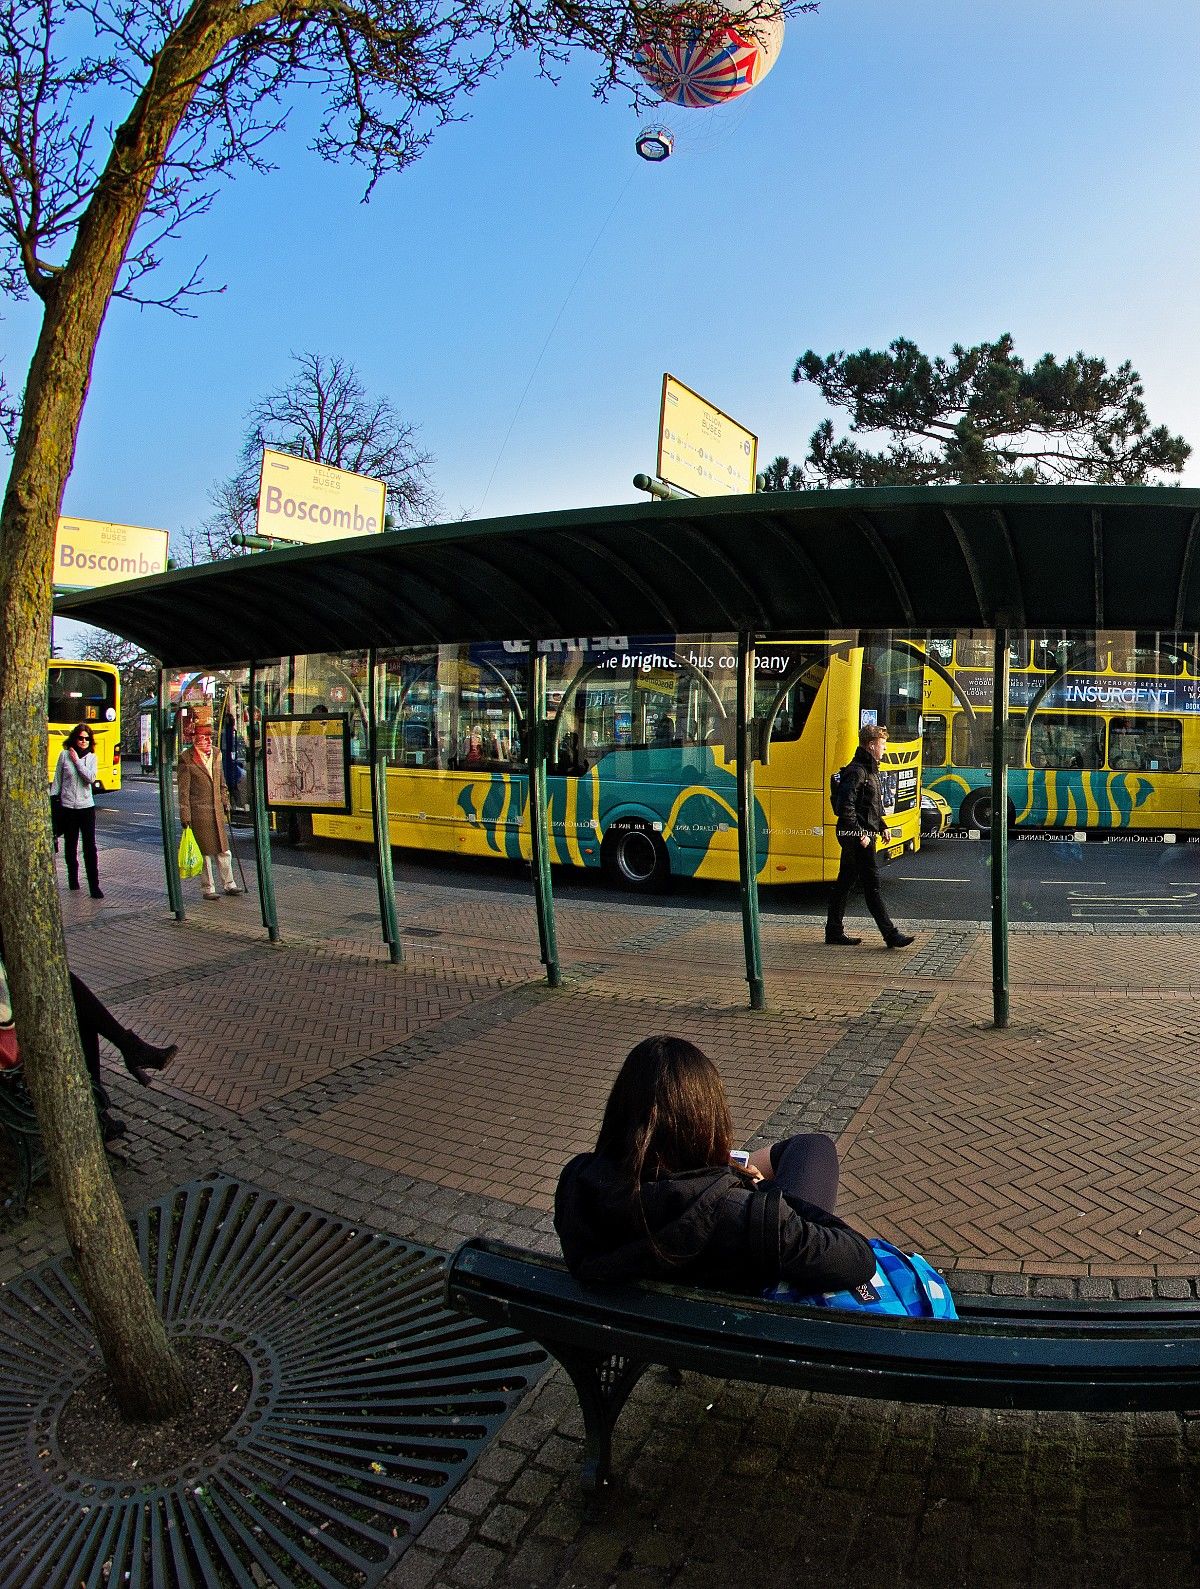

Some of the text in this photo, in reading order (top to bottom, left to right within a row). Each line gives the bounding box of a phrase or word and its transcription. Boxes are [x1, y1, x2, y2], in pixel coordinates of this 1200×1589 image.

[314, 468, 342, 481] YELLOW
[313, 476, 341, 490] BUSES
[265, 485, 377, 533] Boscombe
[101, 533, 127, 542] BUSES
[60, 544, 160, 575] Boscombe
[690, 651, 714, 668] bus
[1065, 685, 1175, 705] INSURGENT
[1185, 702, 1200, 710] BOOK
